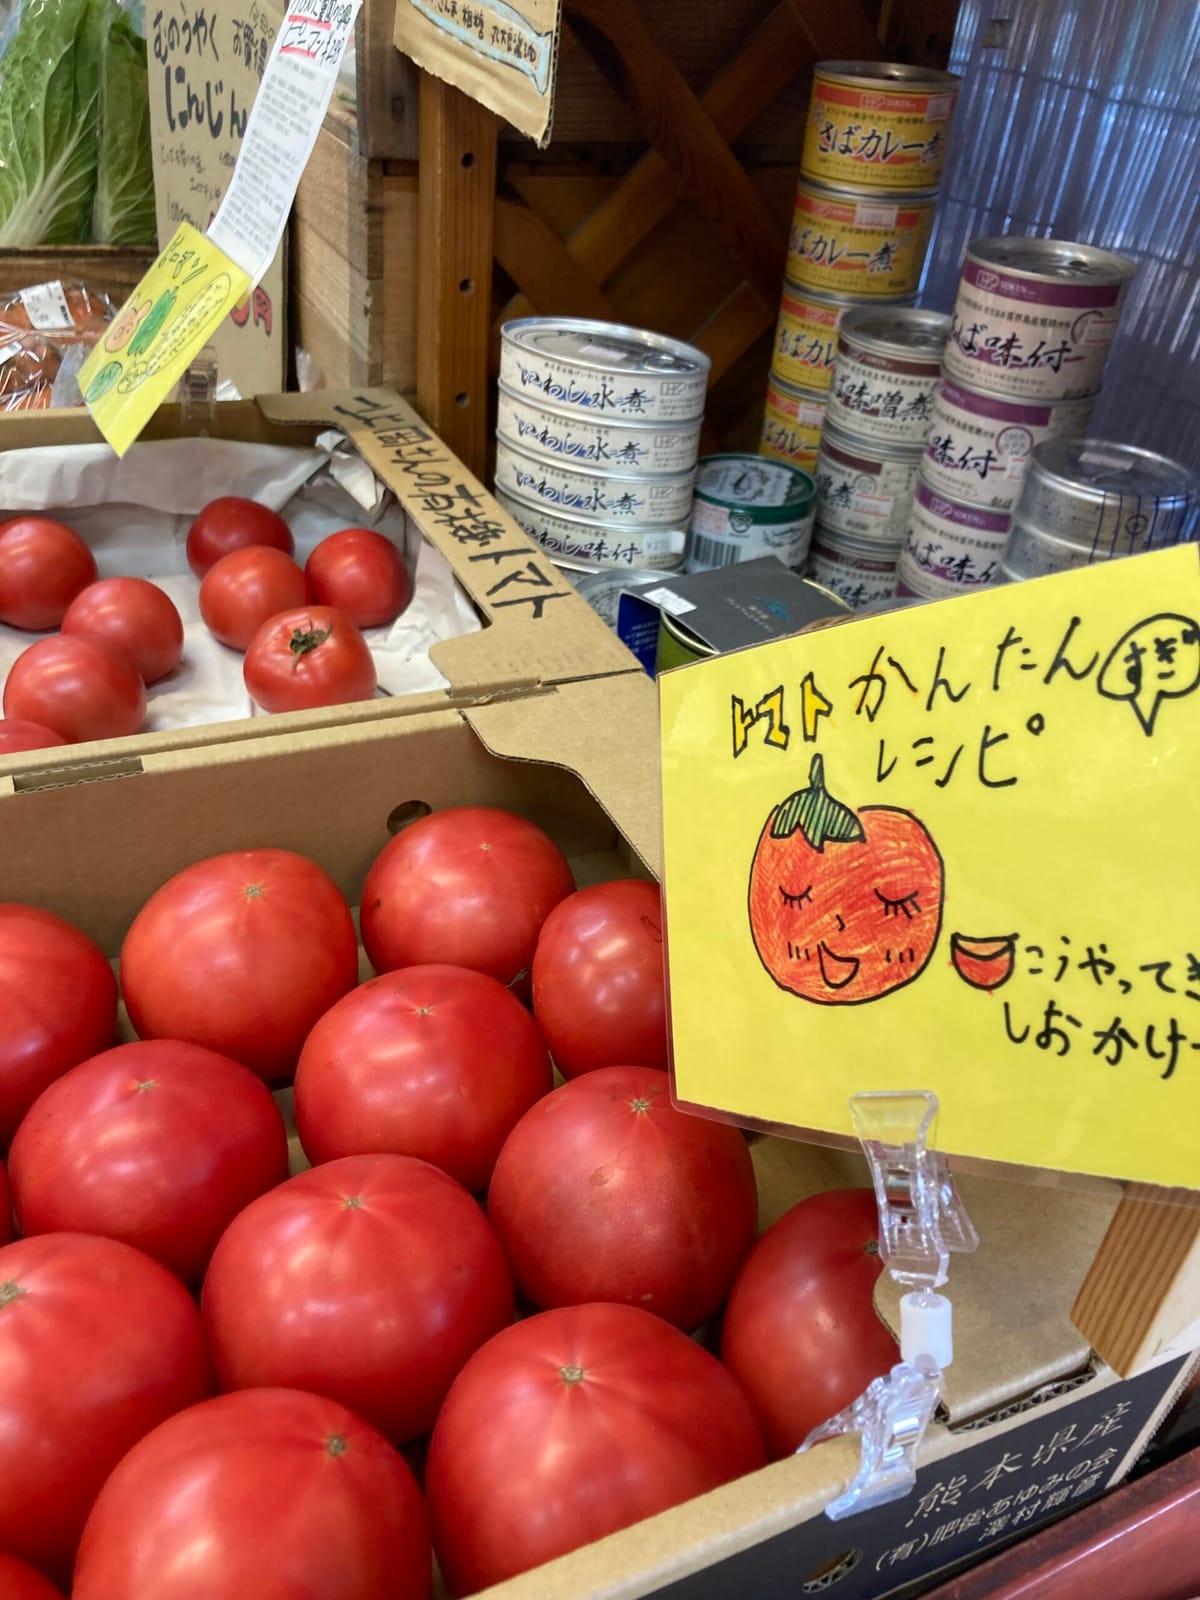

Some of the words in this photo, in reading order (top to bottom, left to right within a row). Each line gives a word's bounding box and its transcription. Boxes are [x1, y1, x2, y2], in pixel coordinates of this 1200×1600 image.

[153, 1, 219, 65] むのうやく
[165, 65, 248, 138] にんじん
[515, 360, 648, 414] いわし水煮
[512, 412, 643, 466] いわし水煮
[511, 463, 639, 516] いわし水煮
[731, 671, 833, 758] トマト
[849, 616, 1099, 722] かんたん
[877, 713, 1046, 788] レシピ
[905, 1401, 1132, 1528] 熊本県産
